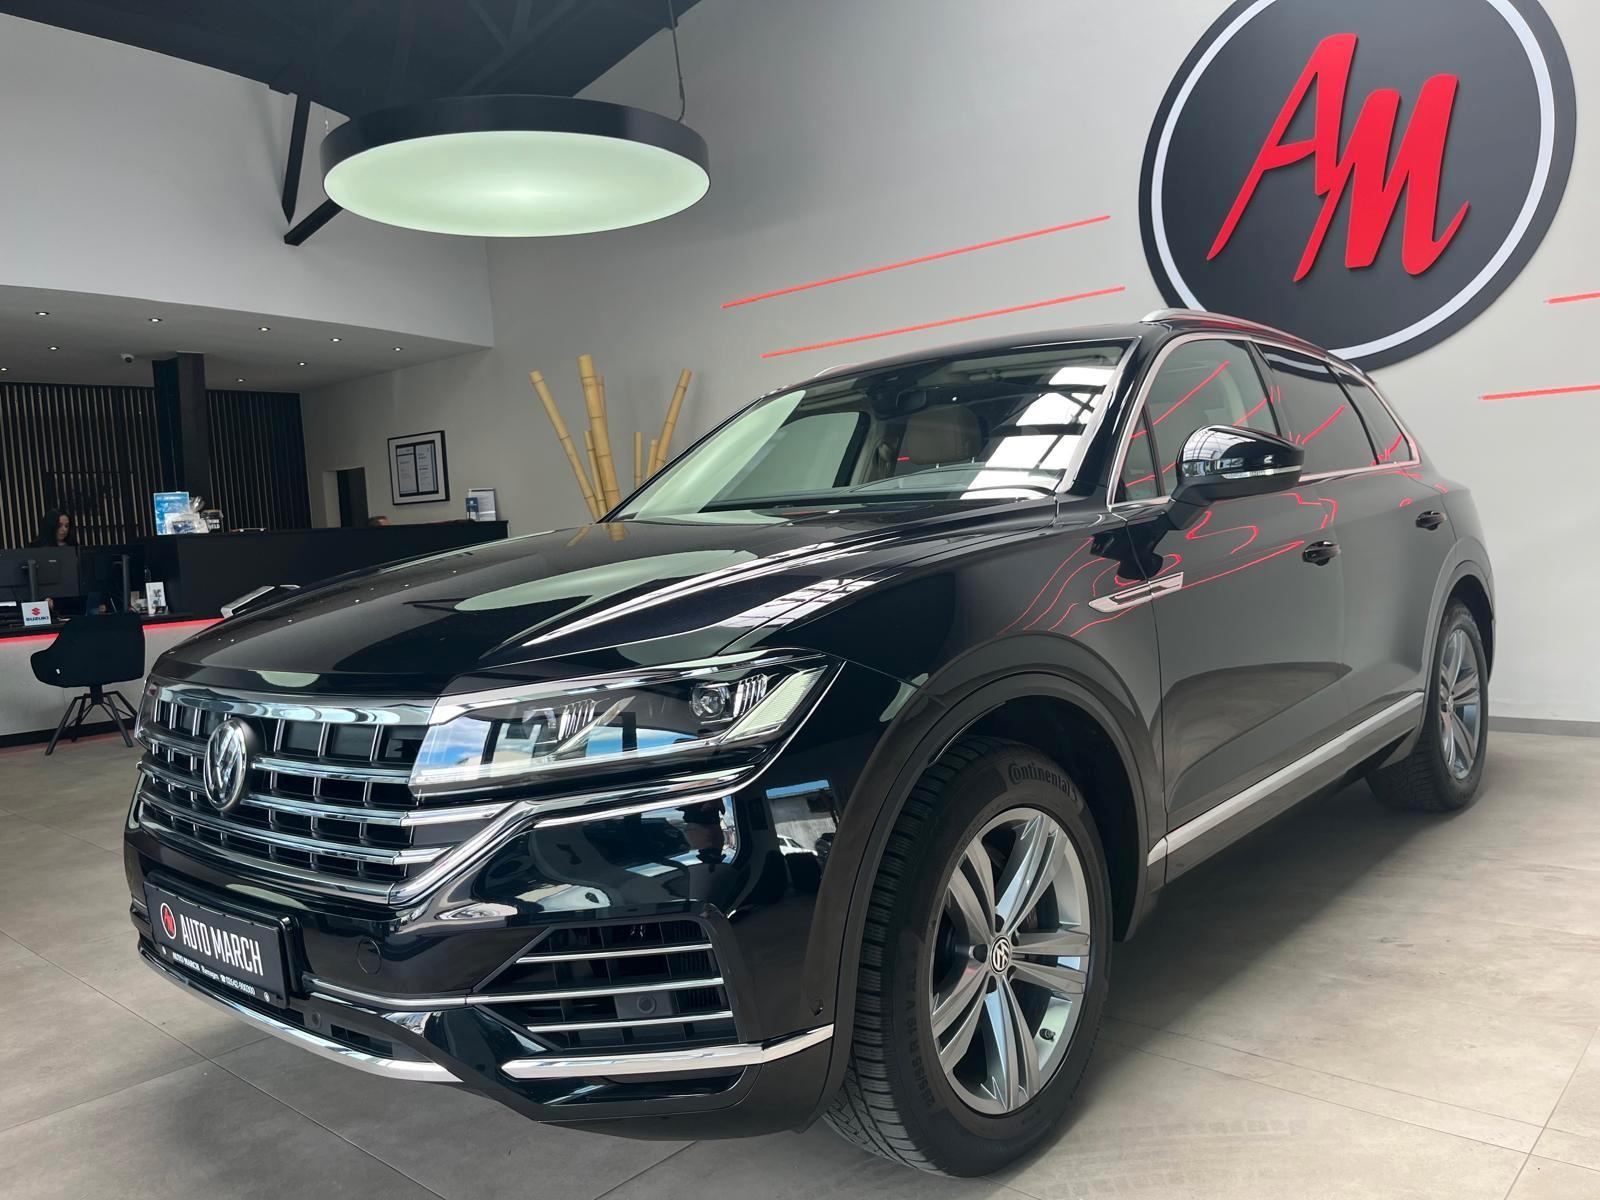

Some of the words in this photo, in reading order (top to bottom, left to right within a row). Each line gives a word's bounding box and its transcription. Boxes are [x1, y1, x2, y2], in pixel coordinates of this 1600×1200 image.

[1206, 33, 1470, 282] AM
[1008, 761, 1071, 798] Continental
[180, 914, 212, 956] AUTO
[210, 926, 264, 976] MARCH
